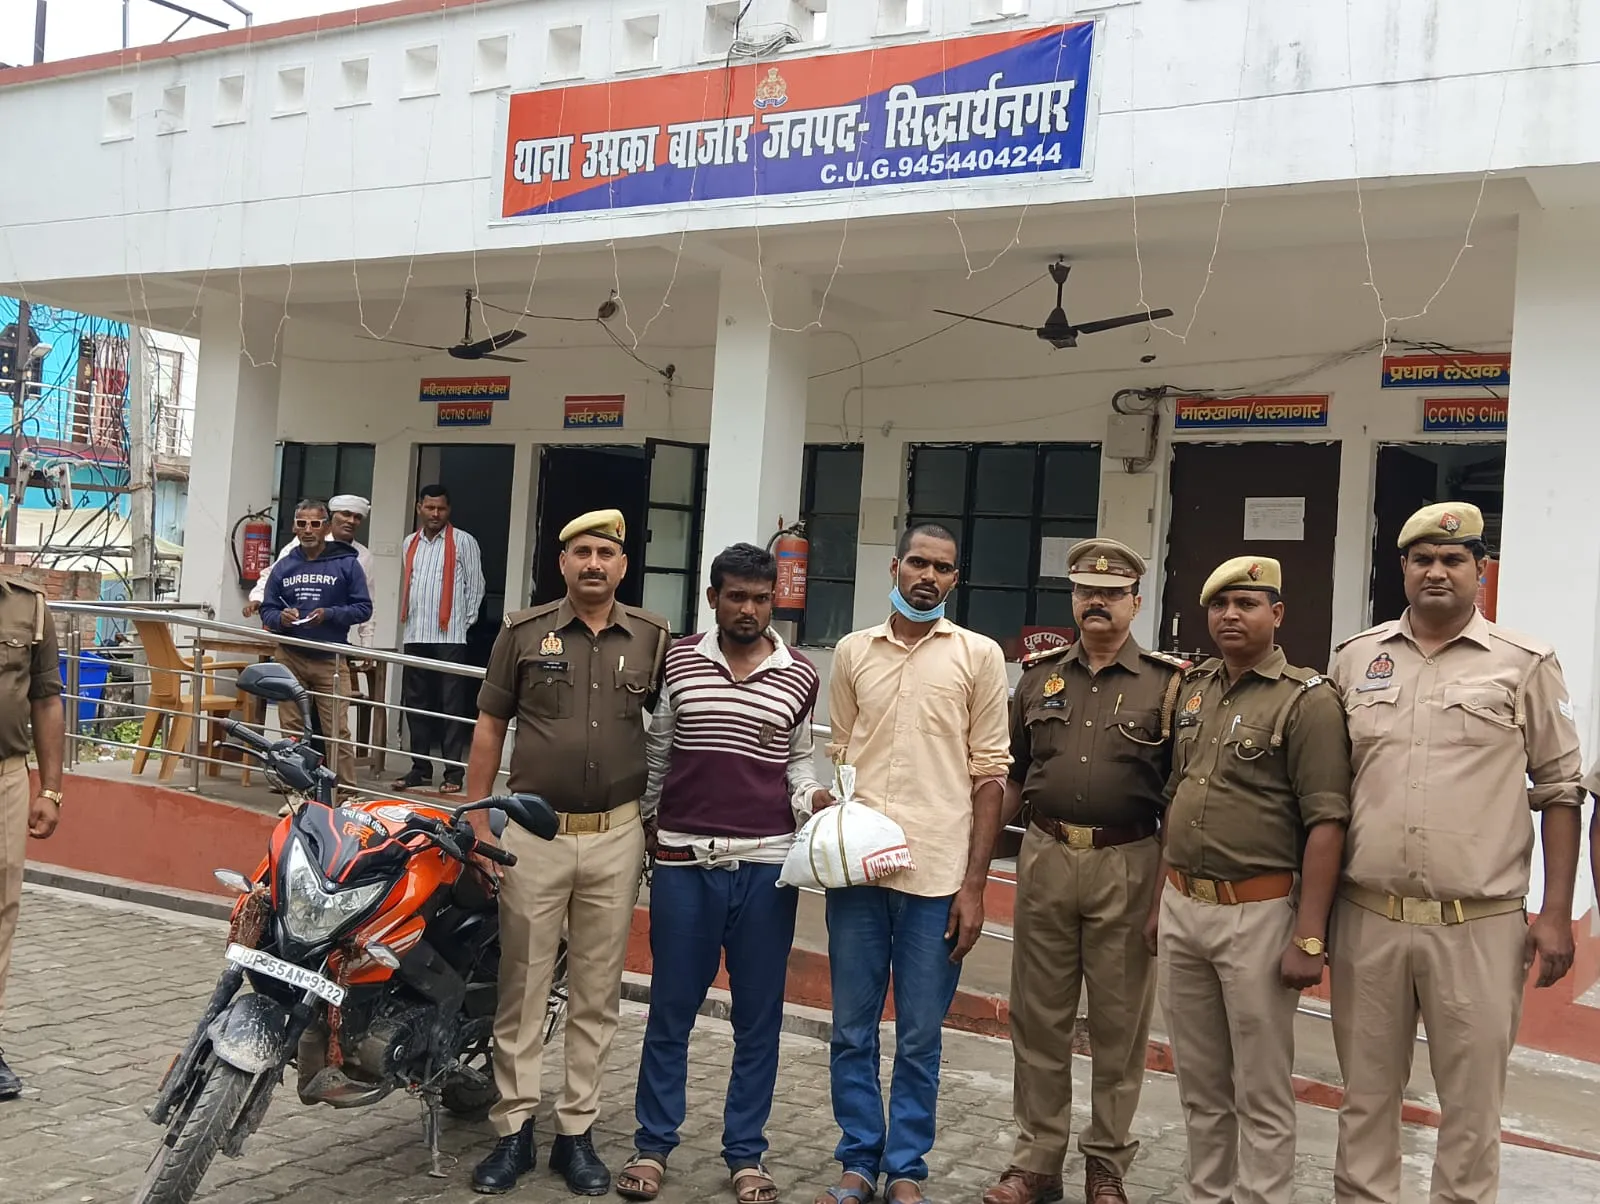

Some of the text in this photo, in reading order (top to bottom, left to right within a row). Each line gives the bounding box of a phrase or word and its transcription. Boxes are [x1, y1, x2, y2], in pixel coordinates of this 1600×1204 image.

[514, 73, 1075, 184] थाना उसका बाजार जनपद- सिद्धार्थनगर
[820, 143, 1062, 184] C.U.G.9454404244
[1389, 360, 1503, 382] प्रधान लेखक
[440, 408, 465, 420] CCTNS
[568, 407, 619, 424] सर्वर रूम
[1181, 401, 1323, 422] मालखाना/शस्त्रागार
[1428, 407, 1475, 423] CCTNS
[282, 573, 338, 587] BURBERRY
